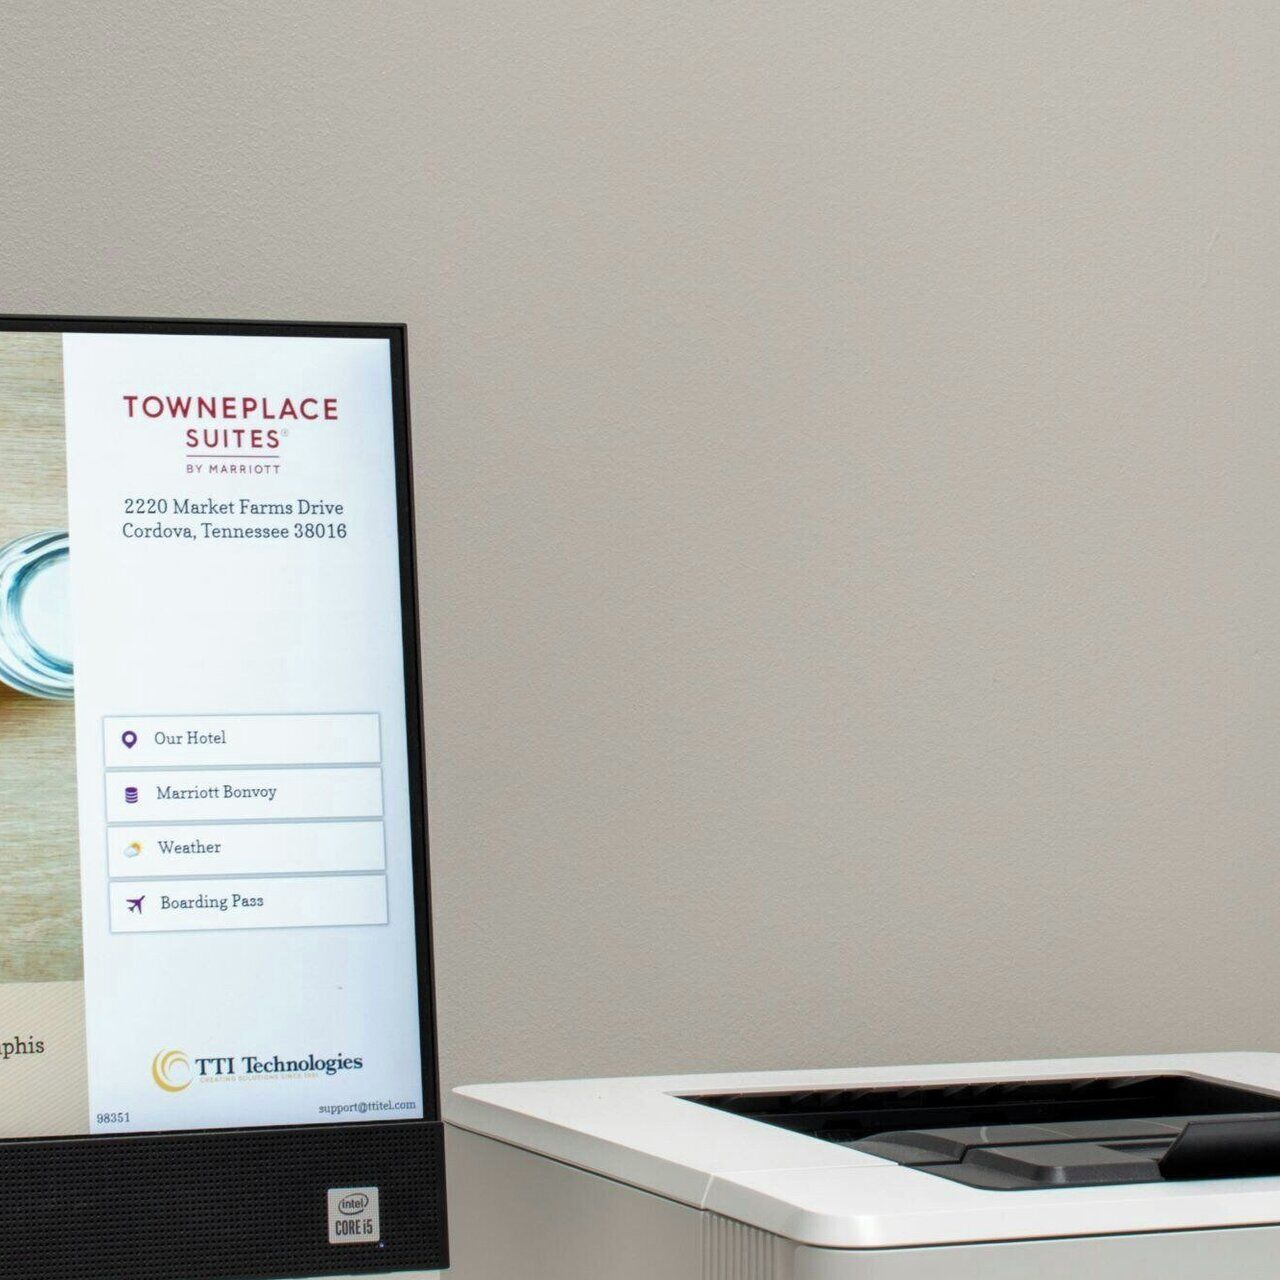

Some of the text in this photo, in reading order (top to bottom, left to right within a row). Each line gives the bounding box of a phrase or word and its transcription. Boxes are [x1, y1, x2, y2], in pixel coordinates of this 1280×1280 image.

[123, 395, 339, 420] TOWNEPLACE
[186, 428, 280, 448] SUITES
[186, 464, 281, 475] BY MARRIOTT
[124, 498, 344, 516] 2220 Market Farms Drive
[122, 523, 347, 541] Cordova, Tennessee 38016
[154, 730, 227, 745] Our Hotel
[156, 785, 277, 800] Marriott Bonvoy
[158, 840, 222, 854] Weather
[160, 895, 265, 911] Boarding Pass
[195, 1053, 364, 1076] TTI Technologies
[318, 1101, 417, 1115] support@ttitel.com
[335, 1218, 373, 1236] CORE i5
